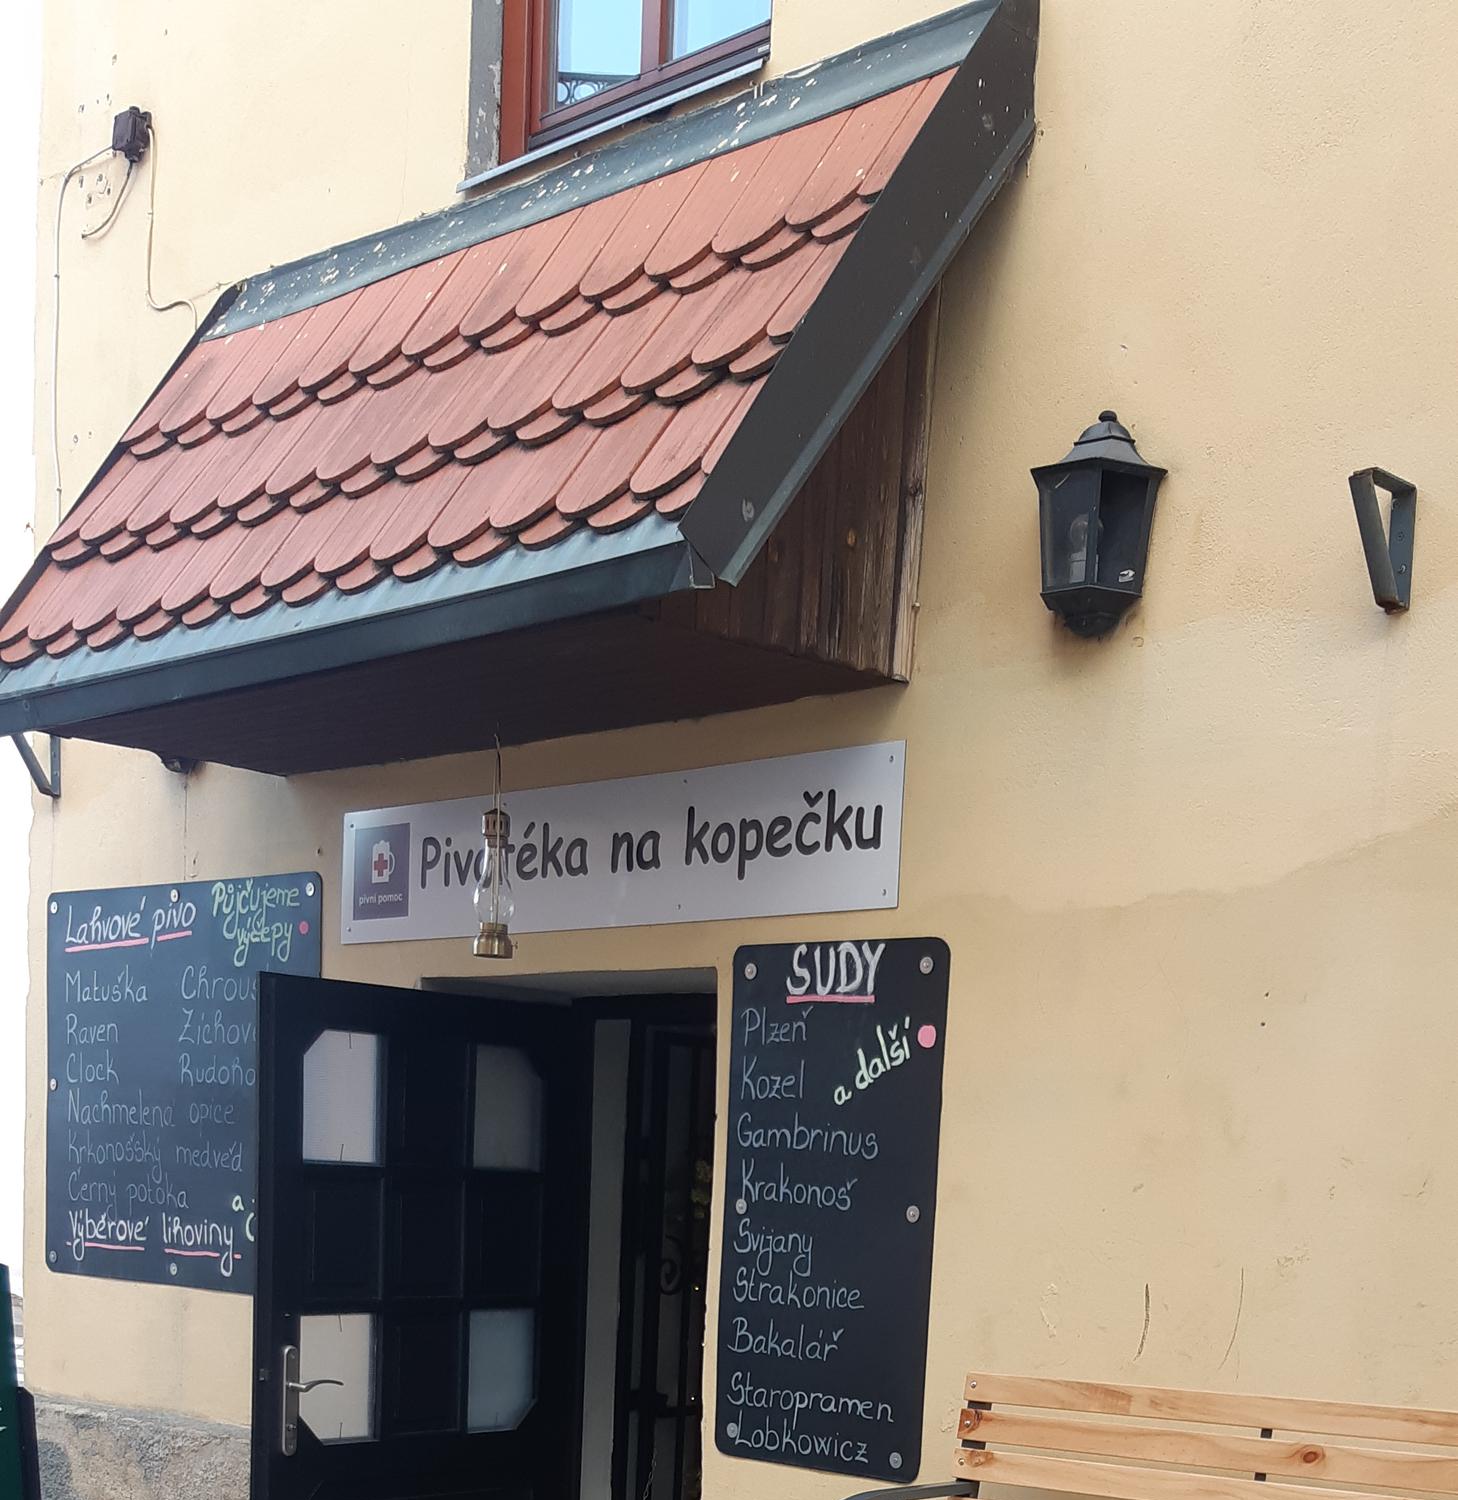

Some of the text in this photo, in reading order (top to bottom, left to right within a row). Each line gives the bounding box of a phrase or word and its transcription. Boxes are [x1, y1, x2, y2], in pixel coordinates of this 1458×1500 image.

[421, 789, 884, 889] Pivotéka na kopečku
[65, 896, 196, 950] Lahvové pivo
[212, 878, 300, 940] Půjčujeme
[378, 893, 403, 904] pomoc
[65, 964, 148, 1002] Matuška
[786, 942, 886, 995] SUDY
[66, 1013, 118, 1045] Raven
[741, 1006, 813, 1046] Plzeň
[66, 1049, 119, 1084] Clock
[740, 1056, 805, 1100] Kozel
[833, 1015, 911, 1105] a další
[68, 1088, 235, 1136] Nachmelená opice
[737, 1112, 879, 1160] Gambrinus
[68, 1167, 189, 1222] Černý potoka
[740, 1158, 858, 1210] Krakonoš
[69, 1208, 150, 1261] Výběrové
[162, 1212, 234, 1277] lihoviny
[733, 1218, 813, 1277] Svijany
[732, 1266, 865, 1309] Strakonice
[727, 1317, 845, 1362] Bakalář
[727, 1371, 894, 1430] Staropramen
[734, 1410, 869, 1464] Lobkowicz
